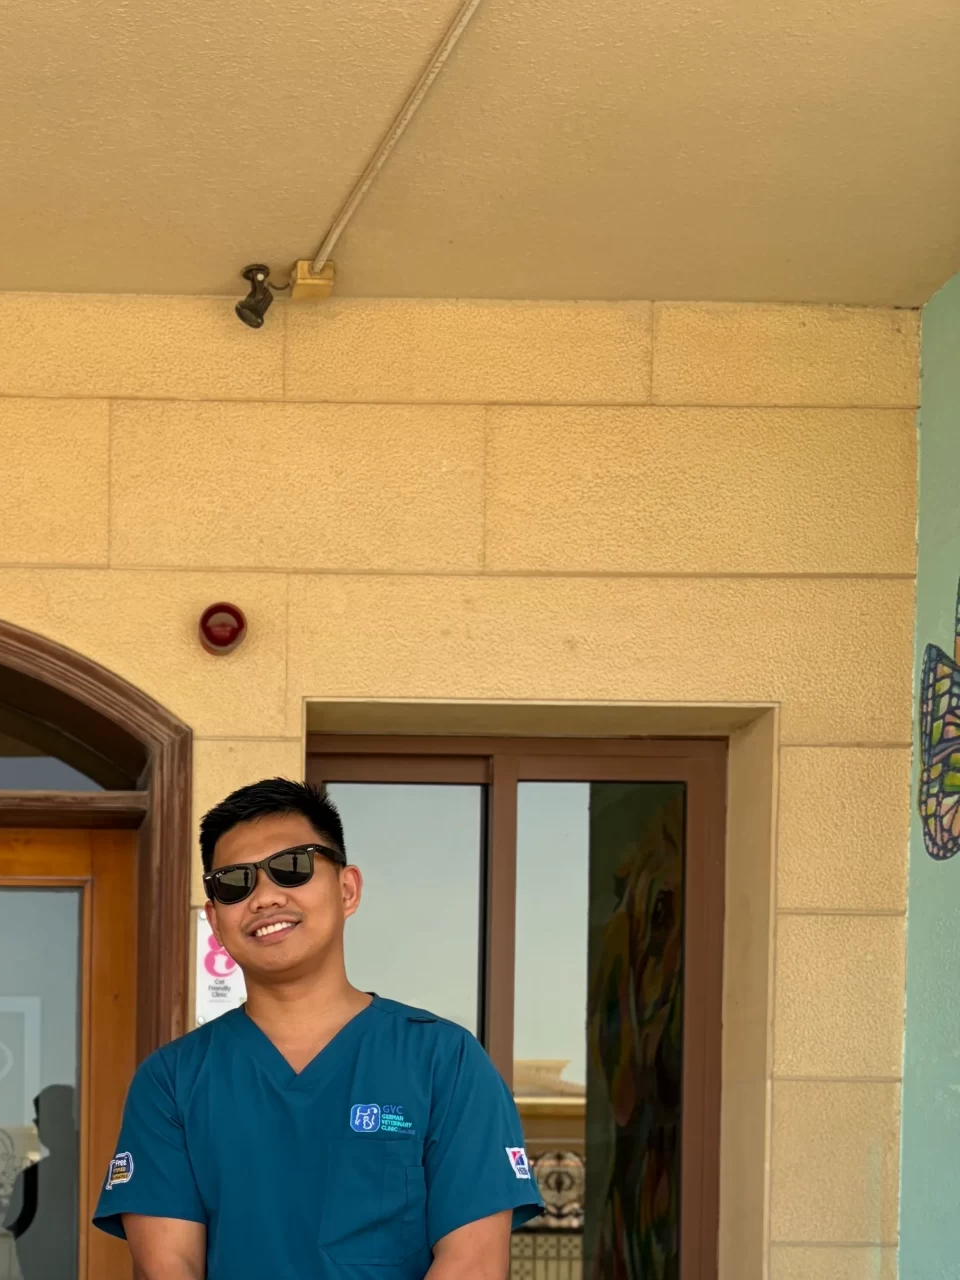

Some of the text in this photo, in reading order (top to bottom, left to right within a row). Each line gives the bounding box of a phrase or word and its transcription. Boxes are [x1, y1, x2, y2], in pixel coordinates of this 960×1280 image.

[382, 1104, 404, 1115] GVC
[381, 1113, 404, 1122] GERMAN
[381, 1119, 413, 1128] VETERINARY
